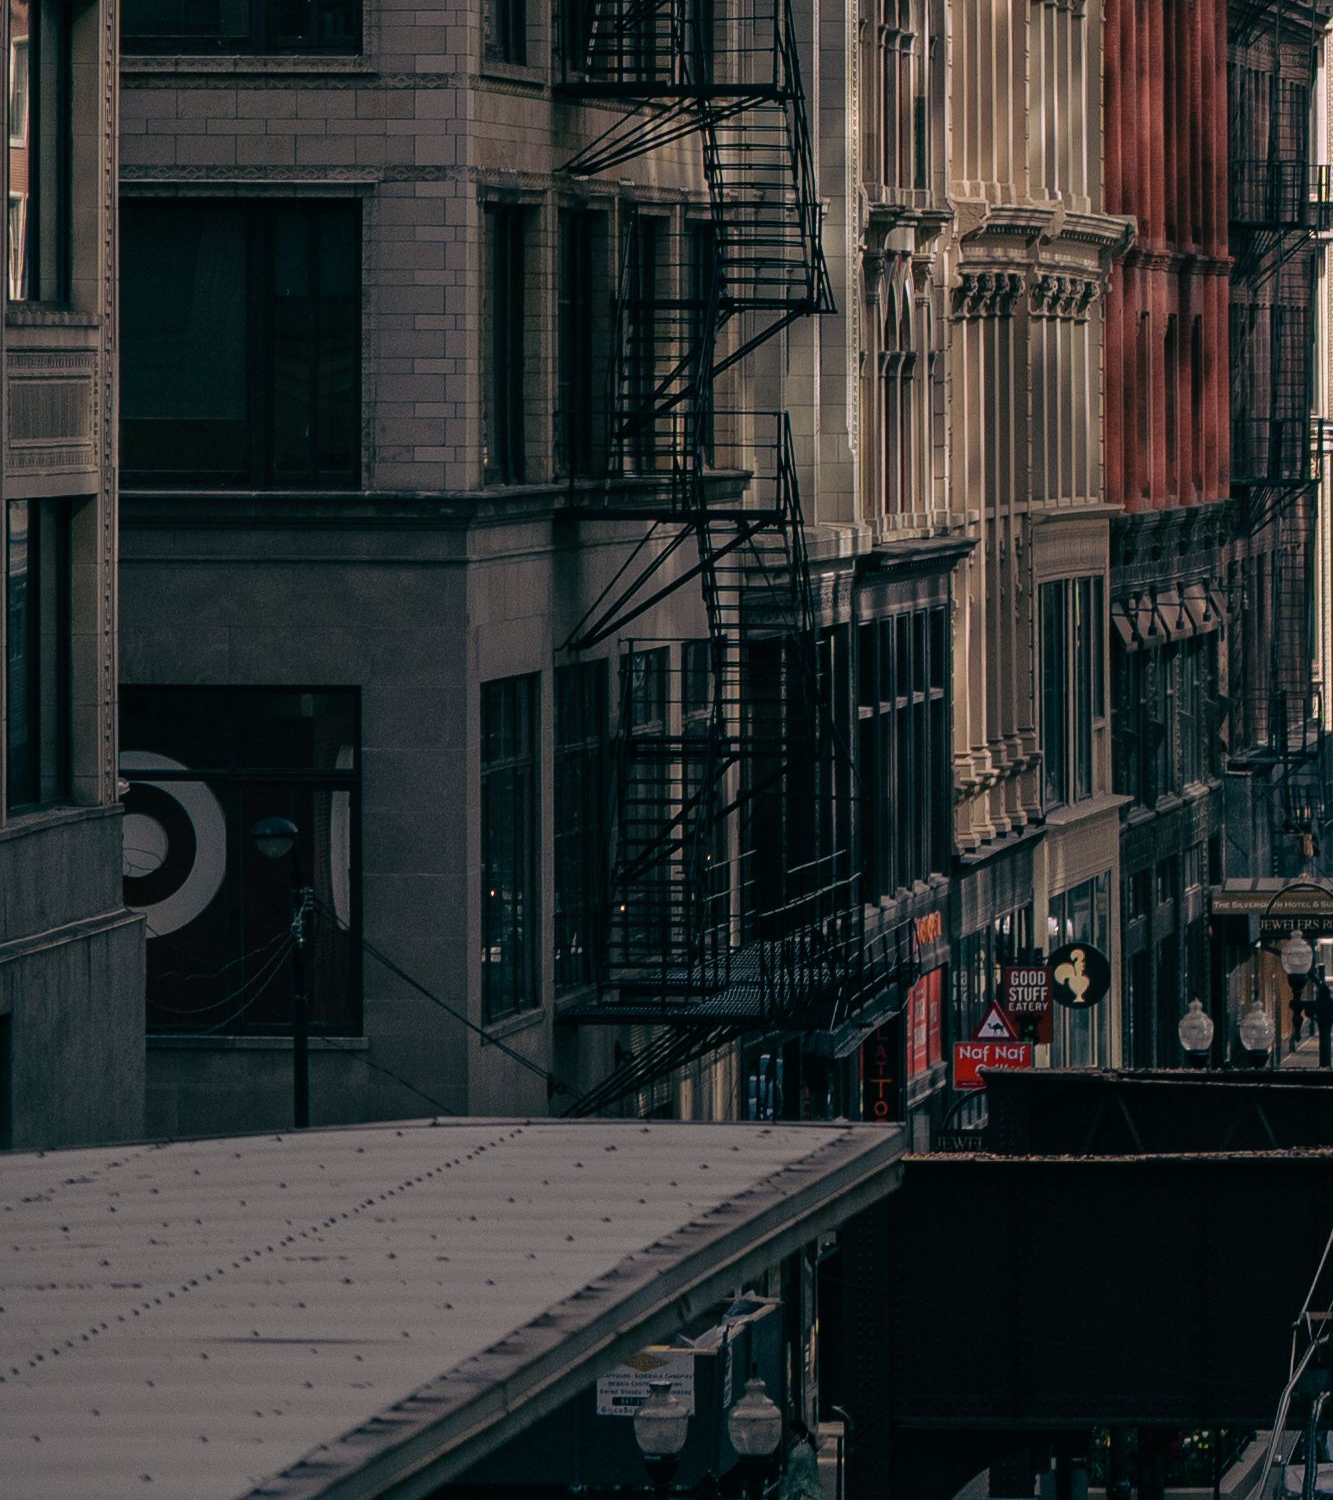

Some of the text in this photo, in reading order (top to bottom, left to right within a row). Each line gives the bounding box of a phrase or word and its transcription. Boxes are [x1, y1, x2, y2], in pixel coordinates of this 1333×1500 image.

[1284, 900, 1311, 909] HOTEL
[1259, 918, 1320, 931] JEWELERS
[1010, 970, 1047, 986] GOOD
[1008, 986, 1049, 1002] STUFF
[1008, 1002, 1049, 1012] EATERY
[959, 1045, 1026, 1062] Naf Naf
